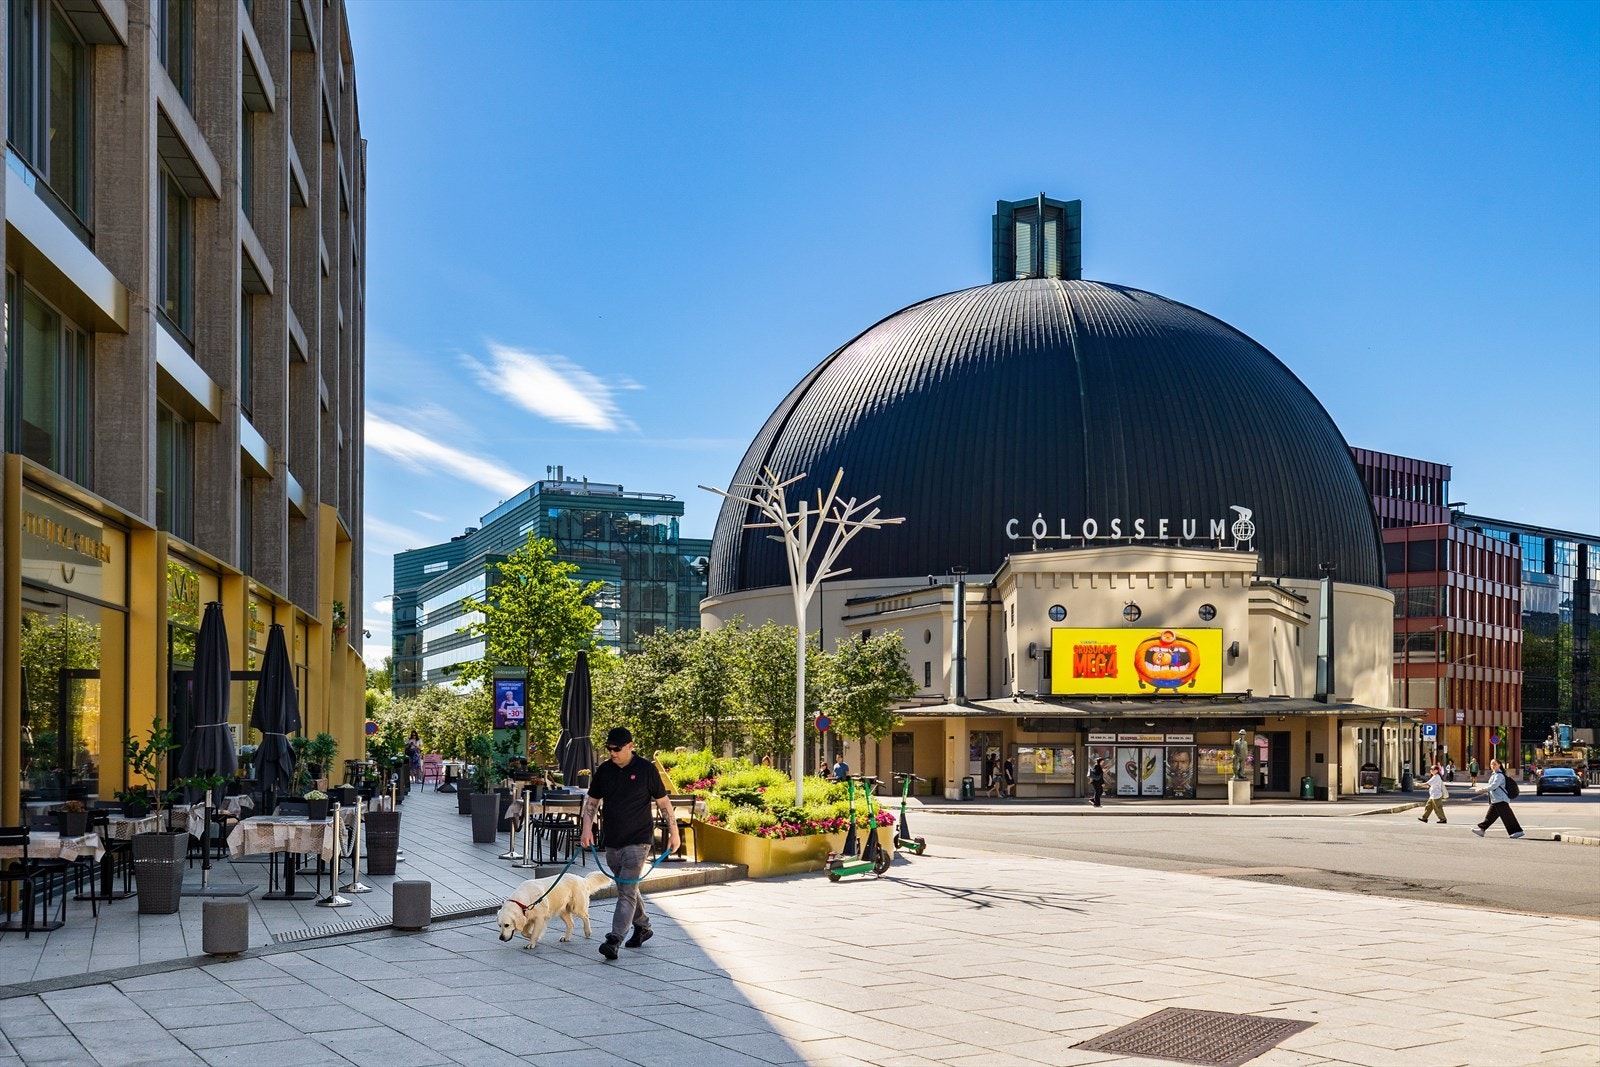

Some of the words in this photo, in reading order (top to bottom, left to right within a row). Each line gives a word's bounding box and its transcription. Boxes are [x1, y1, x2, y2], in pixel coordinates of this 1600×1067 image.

[1006, 518, 1226, 540] COLOSSEUM
[1073, 644, 1117, 654] GRUSOMME
[1073, 653, 1107, 679] MEG
[1426, 725, 1433, 735] P
